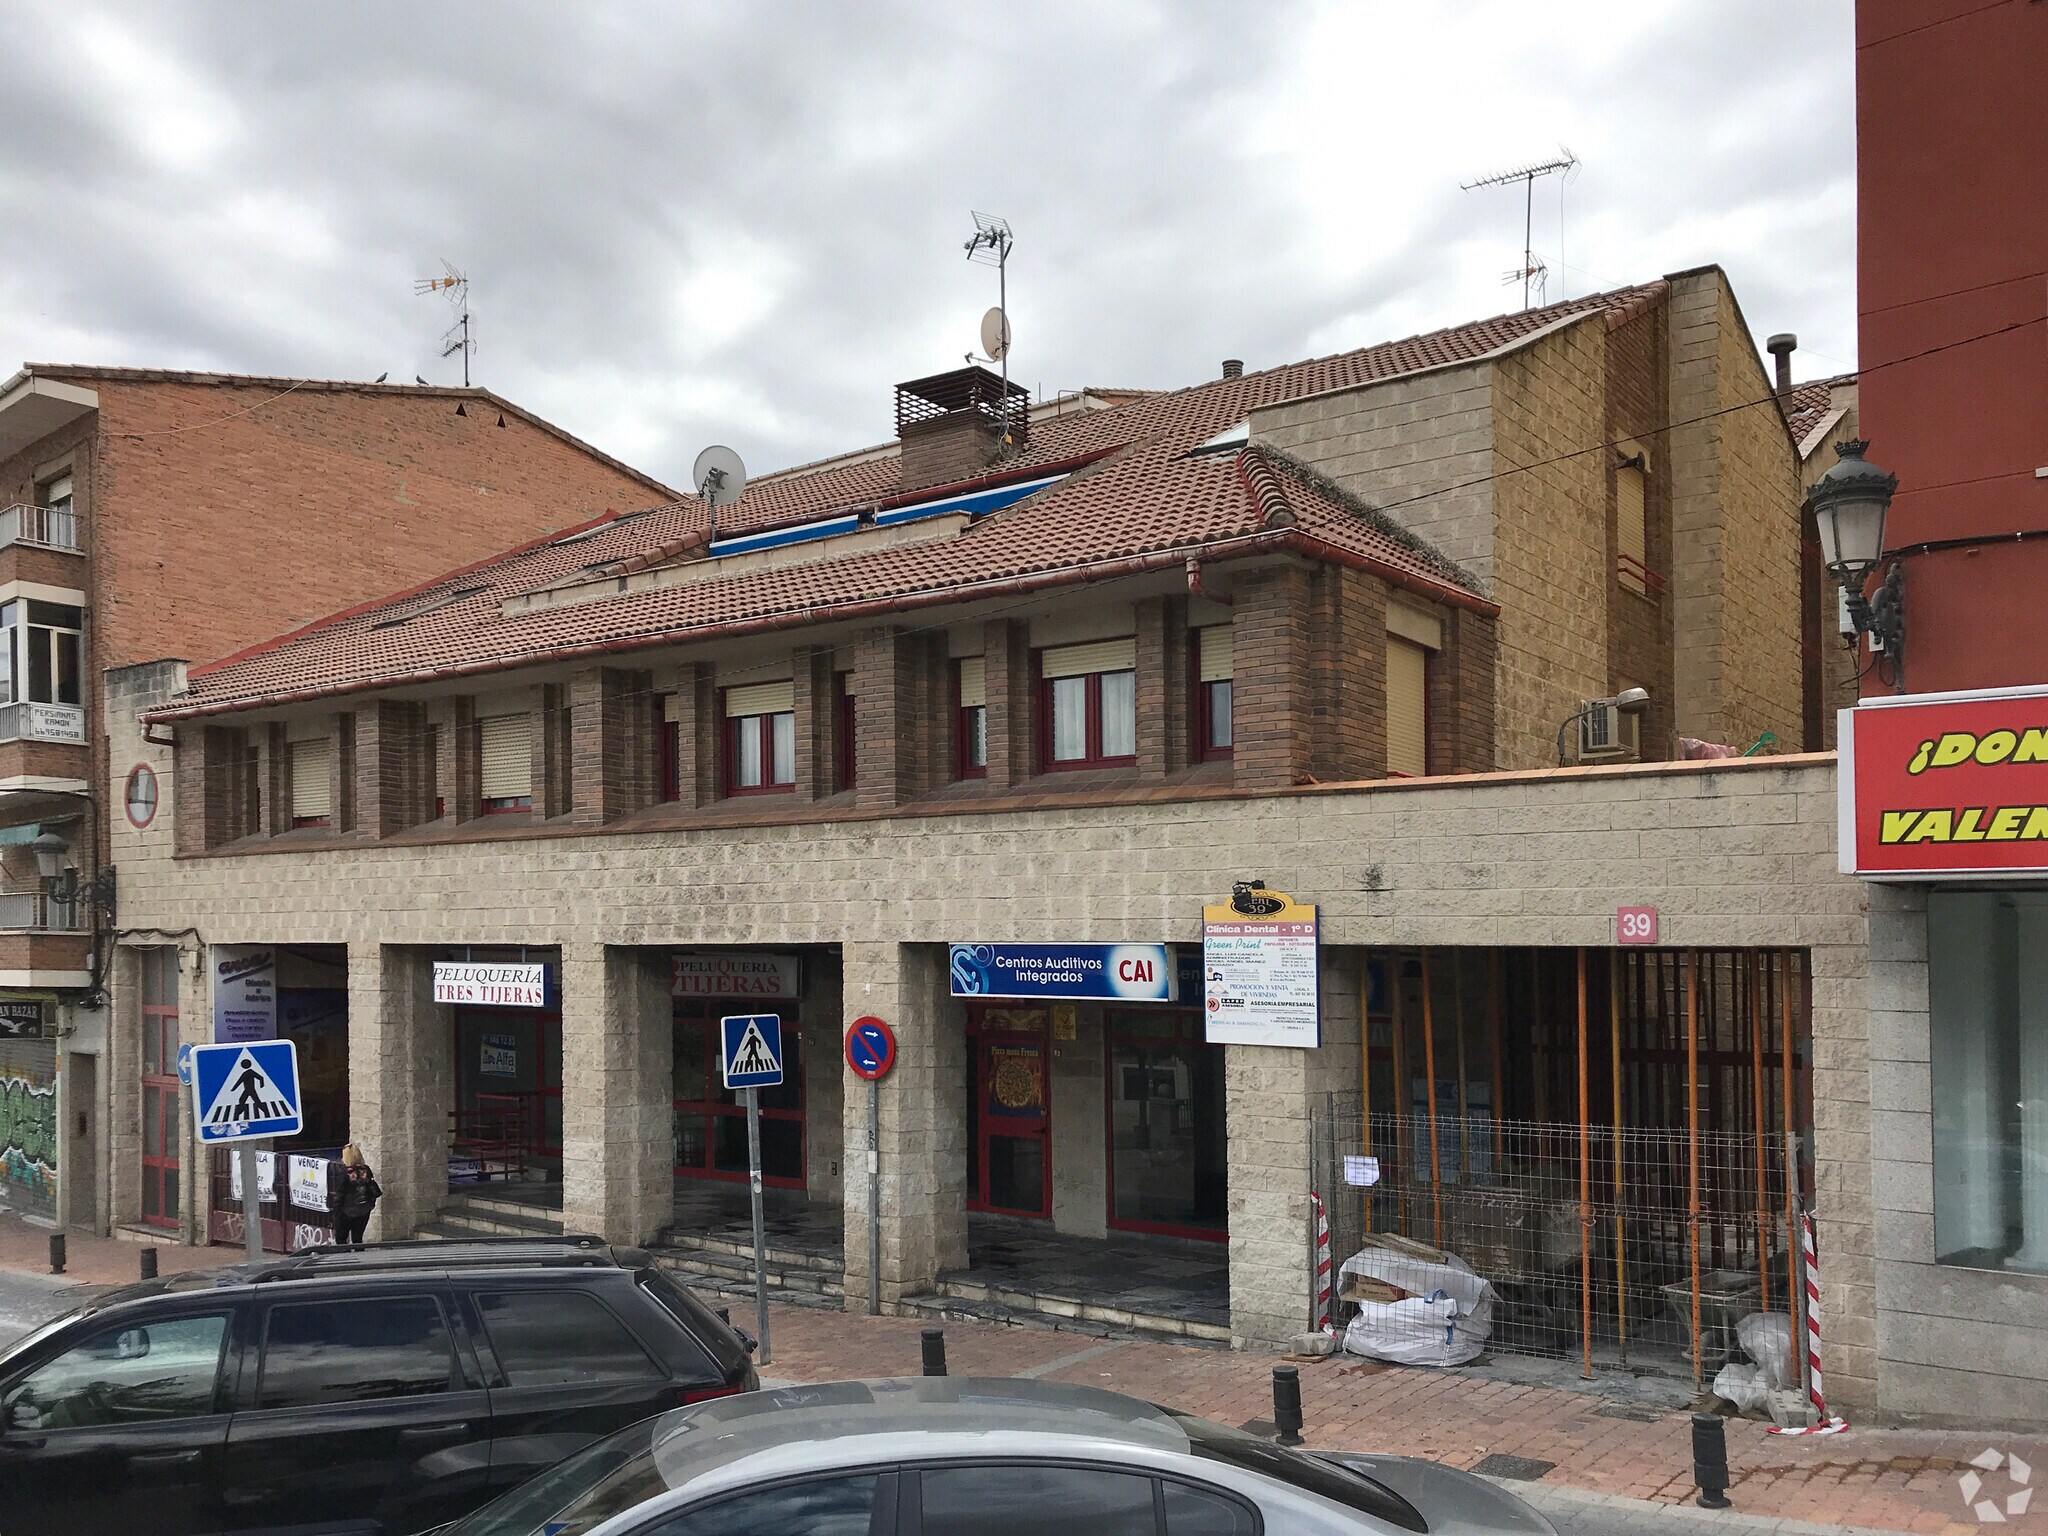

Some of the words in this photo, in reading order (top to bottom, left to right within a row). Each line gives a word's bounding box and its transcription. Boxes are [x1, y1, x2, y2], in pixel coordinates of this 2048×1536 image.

[1249, 904, 1266, 914] 39
[1244, 925, 1278, 933] Dental
[1291, 925, 1300, 933] 1º
[1304, 925, 1313, 933] D
[1622, 913, 1651, 937] 39
[1205, 937, 1233, 950] Green
[1235, 938, 1262, 949] Print
[996, 956, 1043, 969] Centros
[1045, 956, 1102, 969] Auditivos
[433, 967, 542, 984] PELUQUERÍA
[1016, 970, 1083, 985] Integrados
[1119, 960, 1153, 982] CAI
[677, 975, 781, 994] TIJERAS
[437, 985, 473, 1000] TRES
[480, 986, 542, 1004] TIJERAS
[12, 1005, 37, 1019] BAZAR
[496, 1052, 514, 1066] Alfa
[298, 1157, 319, 1169] VENDE
